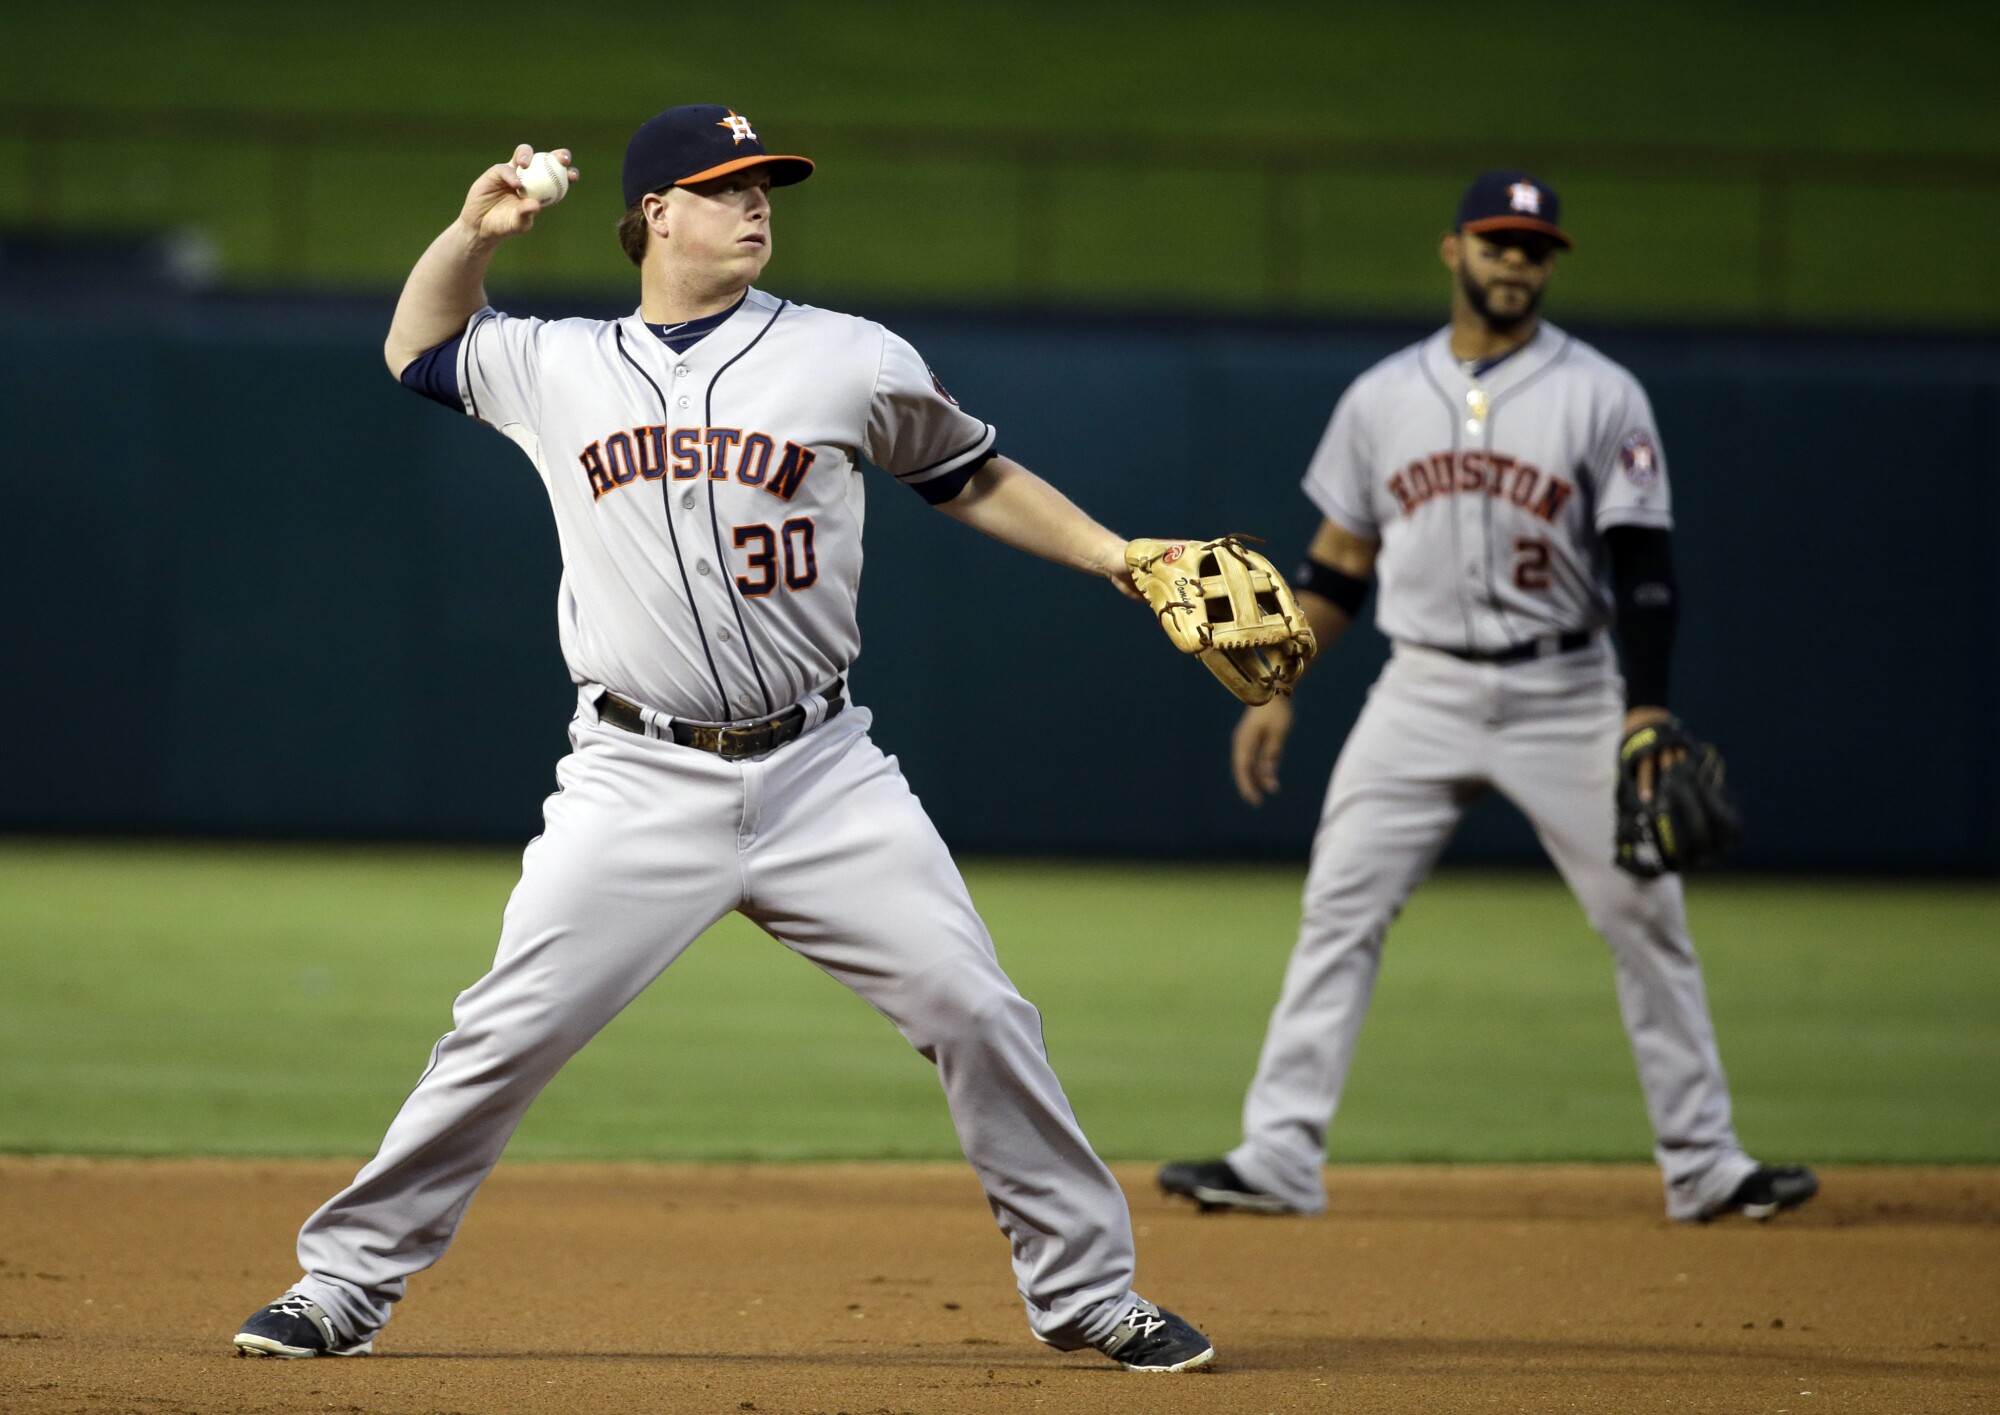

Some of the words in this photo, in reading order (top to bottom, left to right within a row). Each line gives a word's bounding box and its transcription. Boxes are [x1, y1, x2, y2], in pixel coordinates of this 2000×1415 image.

[722, 115, 757, 140] H
[579, 424, 816, 503] HOUSTON
[1386, 447, 1573, 526] HOUSTON
[732, 516, 818, 598] 30
[1512, 534, 1552, 593] 2
